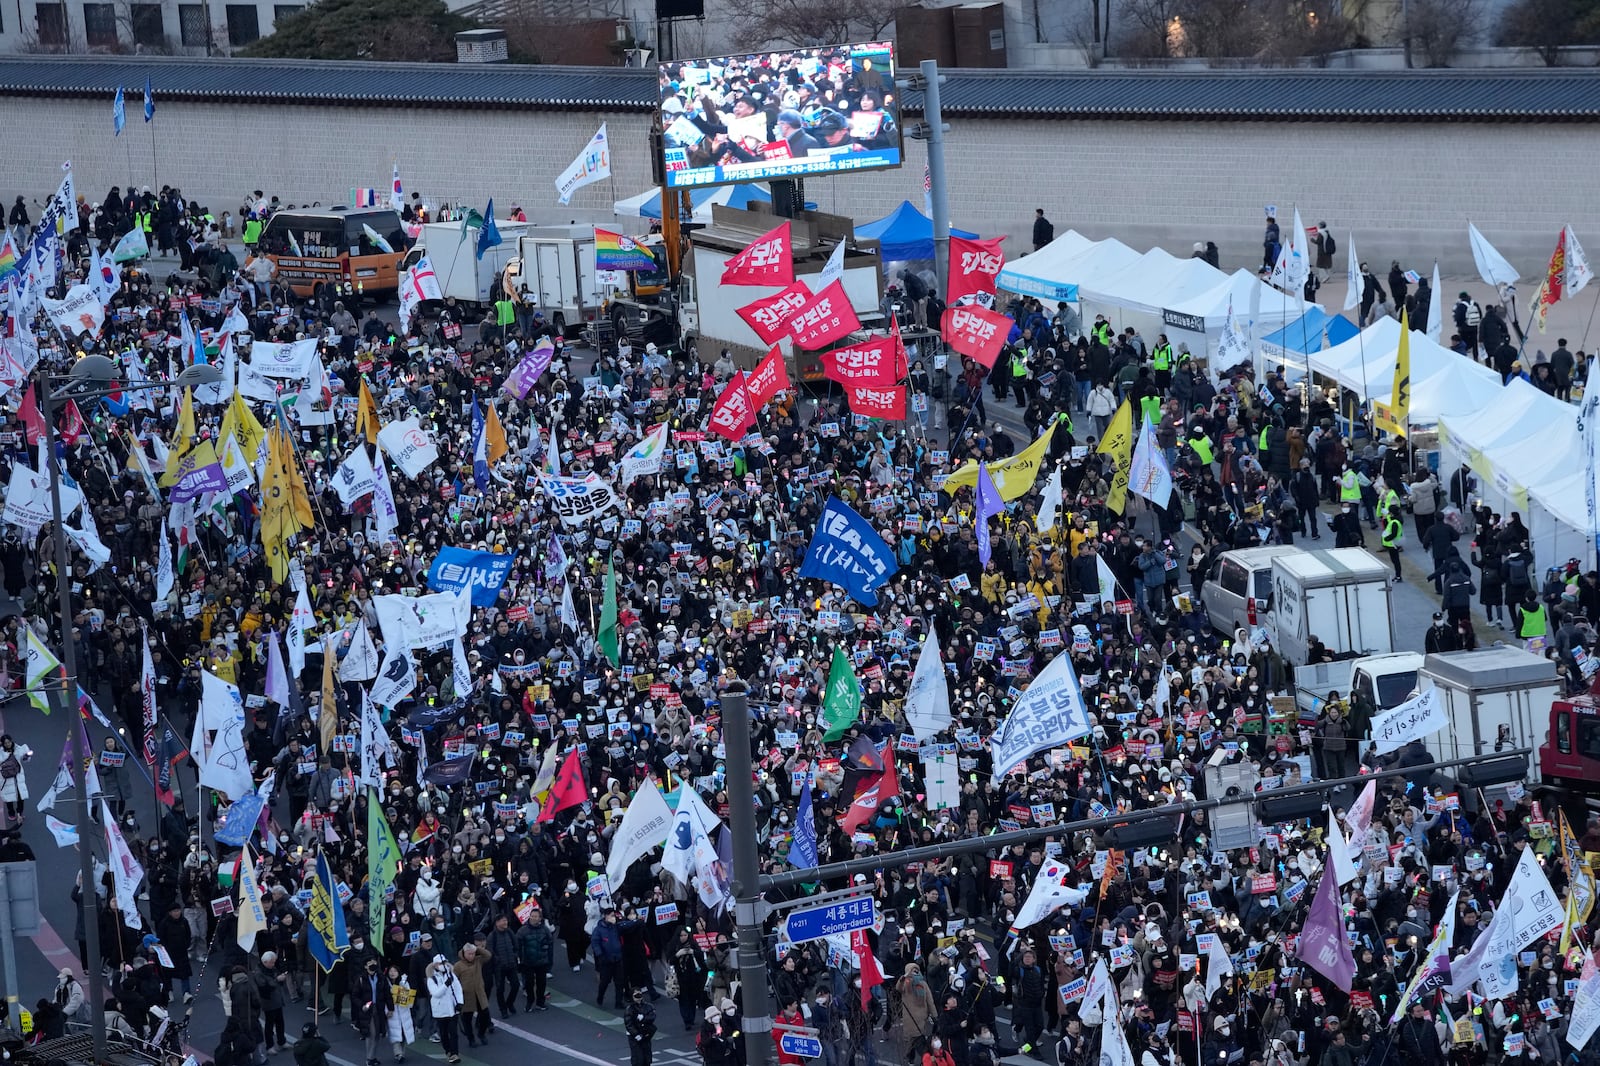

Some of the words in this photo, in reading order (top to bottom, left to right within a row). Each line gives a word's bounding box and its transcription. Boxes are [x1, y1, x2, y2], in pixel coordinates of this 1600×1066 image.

[822, 509, 886, 575] TEAM
[826, 901, 871, 920] 세종대로
[822, 916, 871, 935] Sejong-daero
